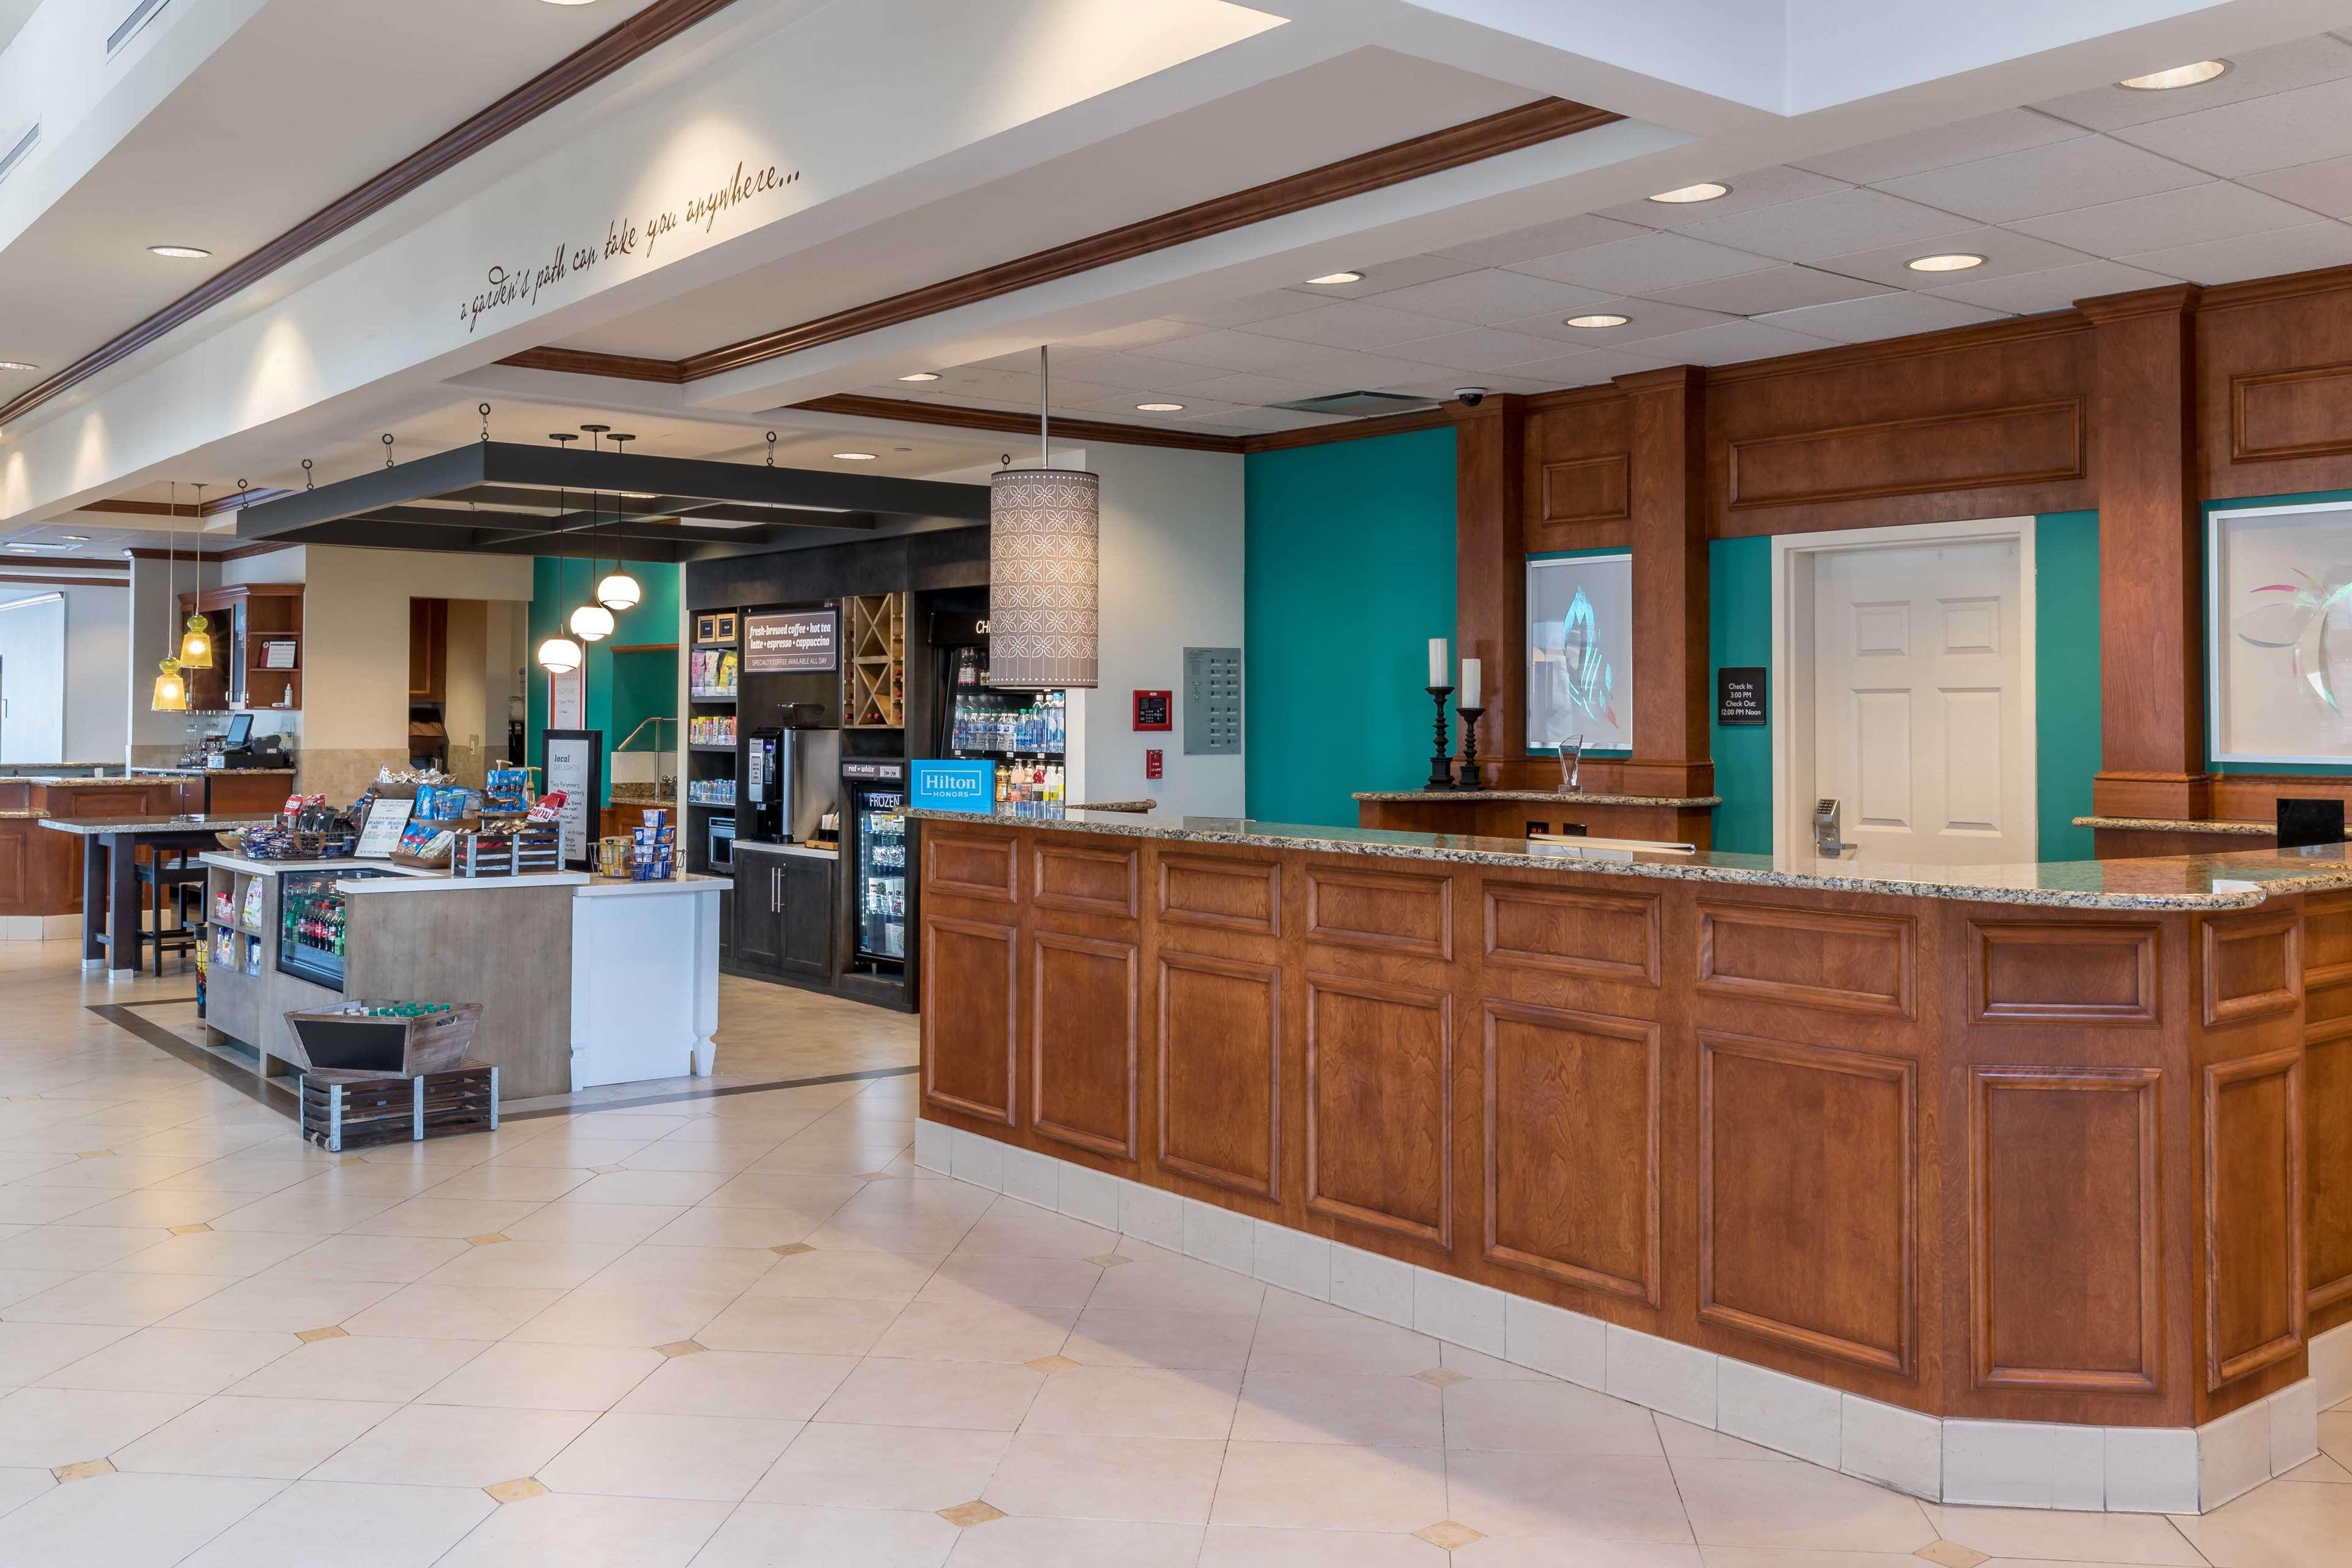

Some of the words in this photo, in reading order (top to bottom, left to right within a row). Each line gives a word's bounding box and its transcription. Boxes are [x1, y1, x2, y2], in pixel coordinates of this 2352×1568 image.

[461, 303, 467, 320] a
[469, 266, 530, 333] garden's
[532, 243, 567, 307] path
[573, 246, 598, 271] can
[604, 217, 639, 260] take
[645, 211, 677, 258] you
[686, 160, 799, 233] anywhere...
[749, 624, 788, 639] fresh-brewed
[788, 623, 806, 637] coffee
[810, 622, 821, 633] hot
[821, 623, 831, 633] tea
[750, 639, 764, 649] latte
[767, 639, 792, 650] espresso
[796, 635, 830, 649] cappuccino
[554, 754, 570, 763] local
[925, 775, 976, 789] Hilton
[869, 794, 900, 808] FROZEN
